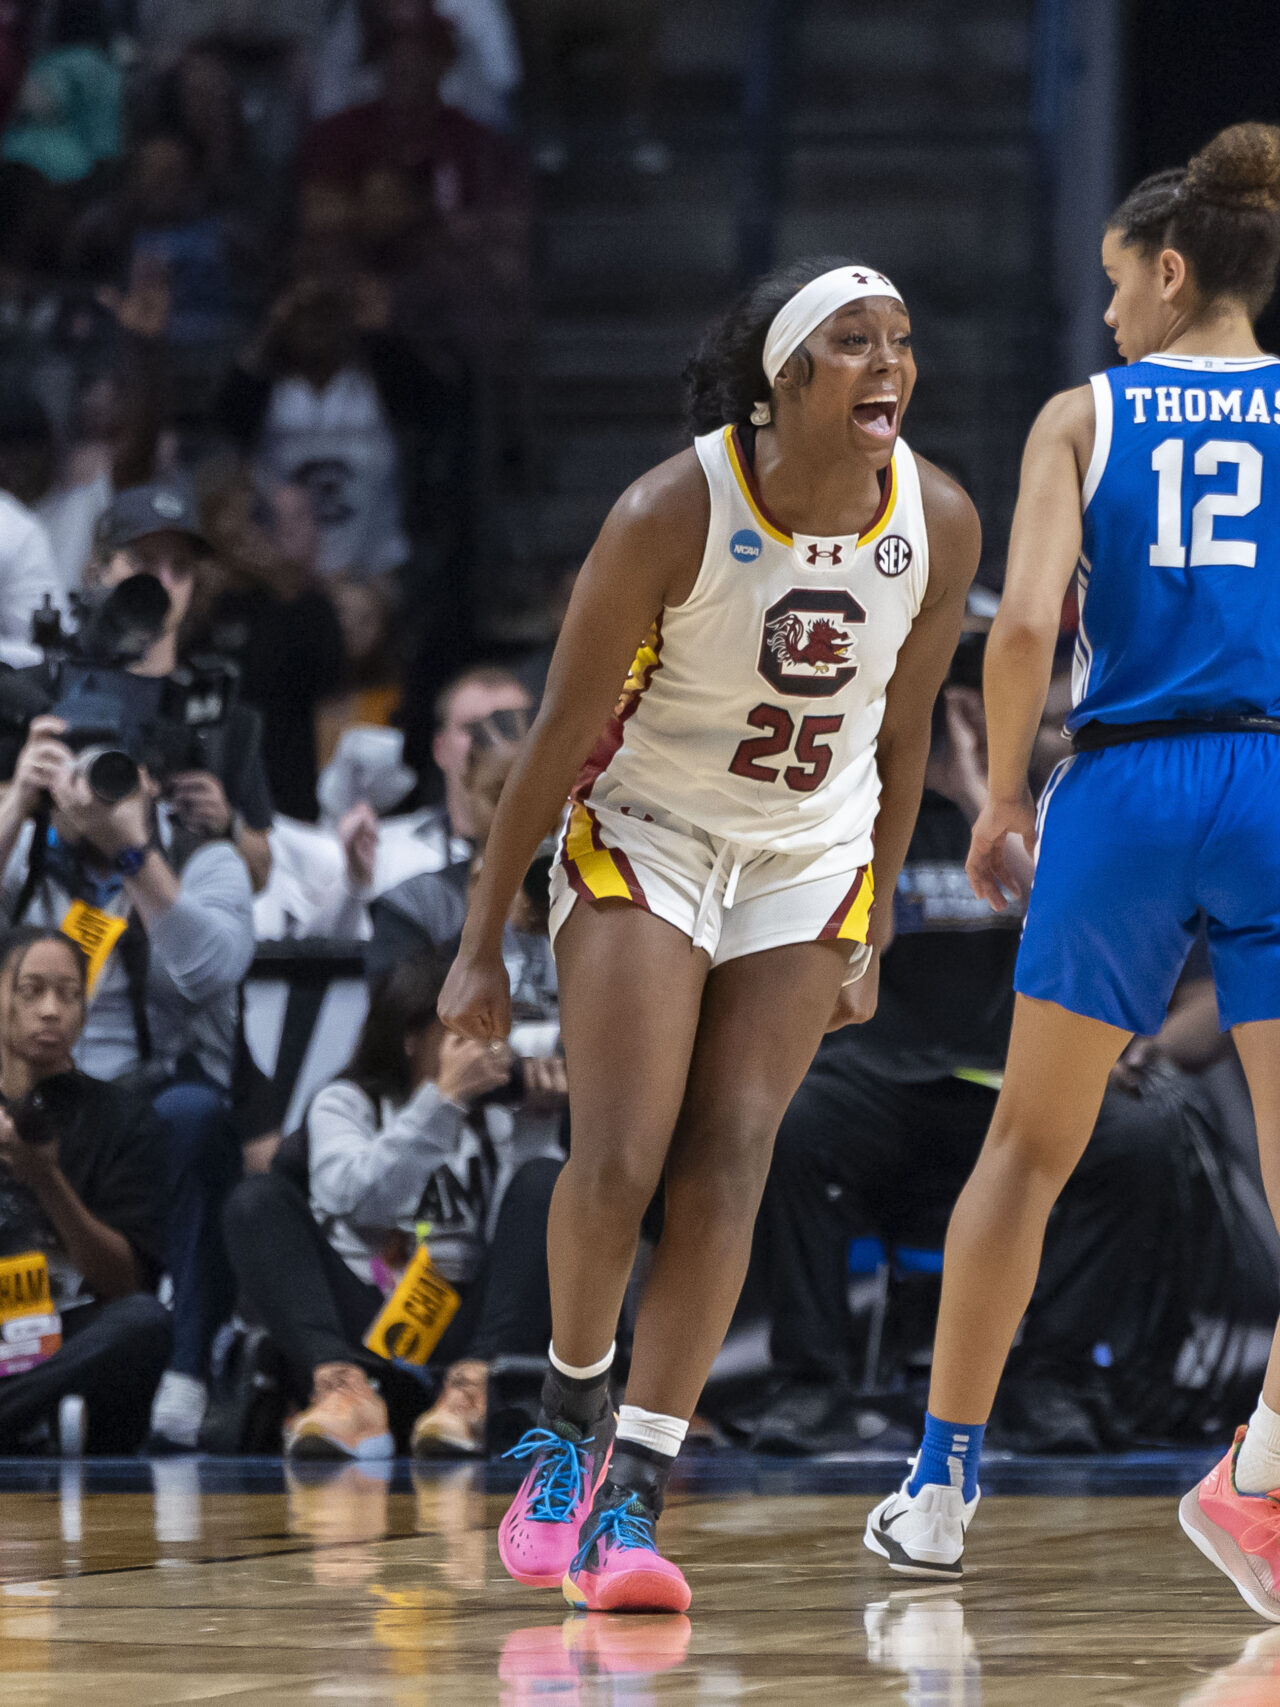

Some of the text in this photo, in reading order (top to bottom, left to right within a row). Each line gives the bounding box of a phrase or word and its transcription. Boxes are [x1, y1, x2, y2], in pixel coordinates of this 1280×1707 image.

[1148, 438, 1264, 569] 12
[733, 544, 760, 556] NCAA
[878, 537, 910, 574] SEC
[728, 702, 845, 793] 25
